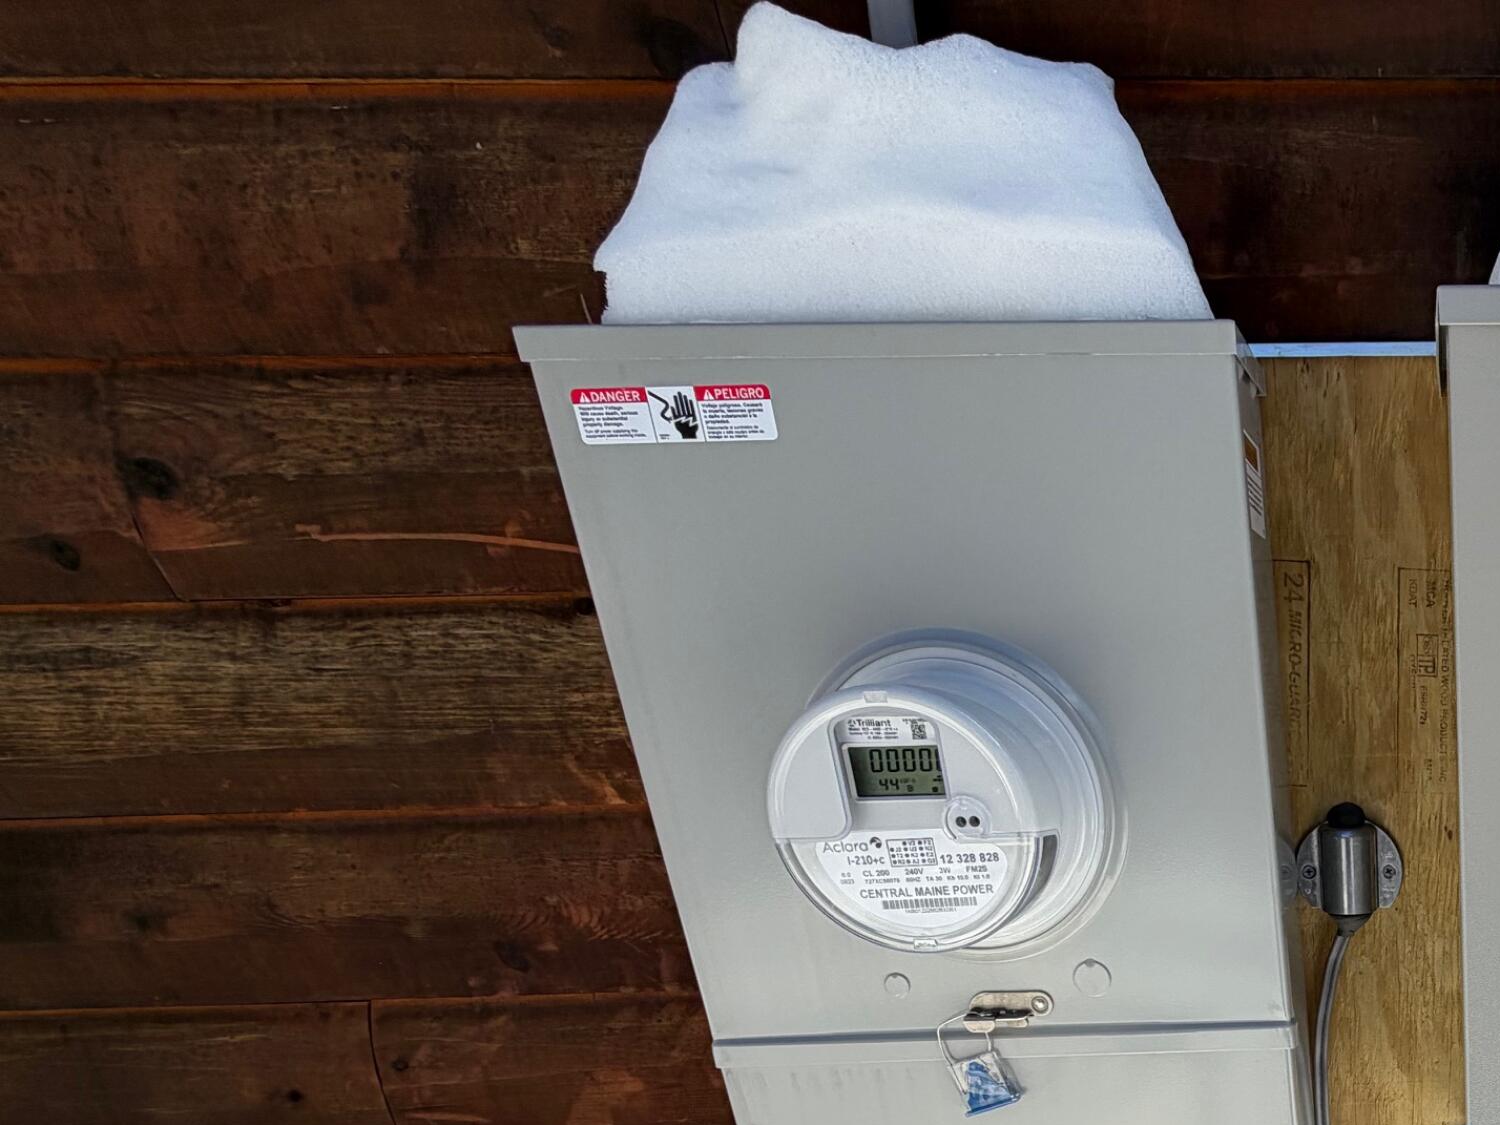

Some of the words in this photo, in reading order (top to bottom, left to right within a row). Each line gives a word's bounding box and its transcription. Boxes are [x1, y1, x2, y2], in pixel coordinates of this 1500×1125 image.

[590, 390, 641, 403] DANGER
[714, 386, 764, 399] PELIGRO
[1284, 572, 1305, 603] 24
[856, 718, 892, 727] Trilliant
[822, 840, 868, 854] Aclara
[940, 855, 954, 864] 12
[956, 853, 976, 863] 328
[979, 852, 1000, 862] 828
[860, 888, 912, 900] CENTRAL
[915, 886, 950, 897] MAINE
[953, 884, 994, 895] POWER
